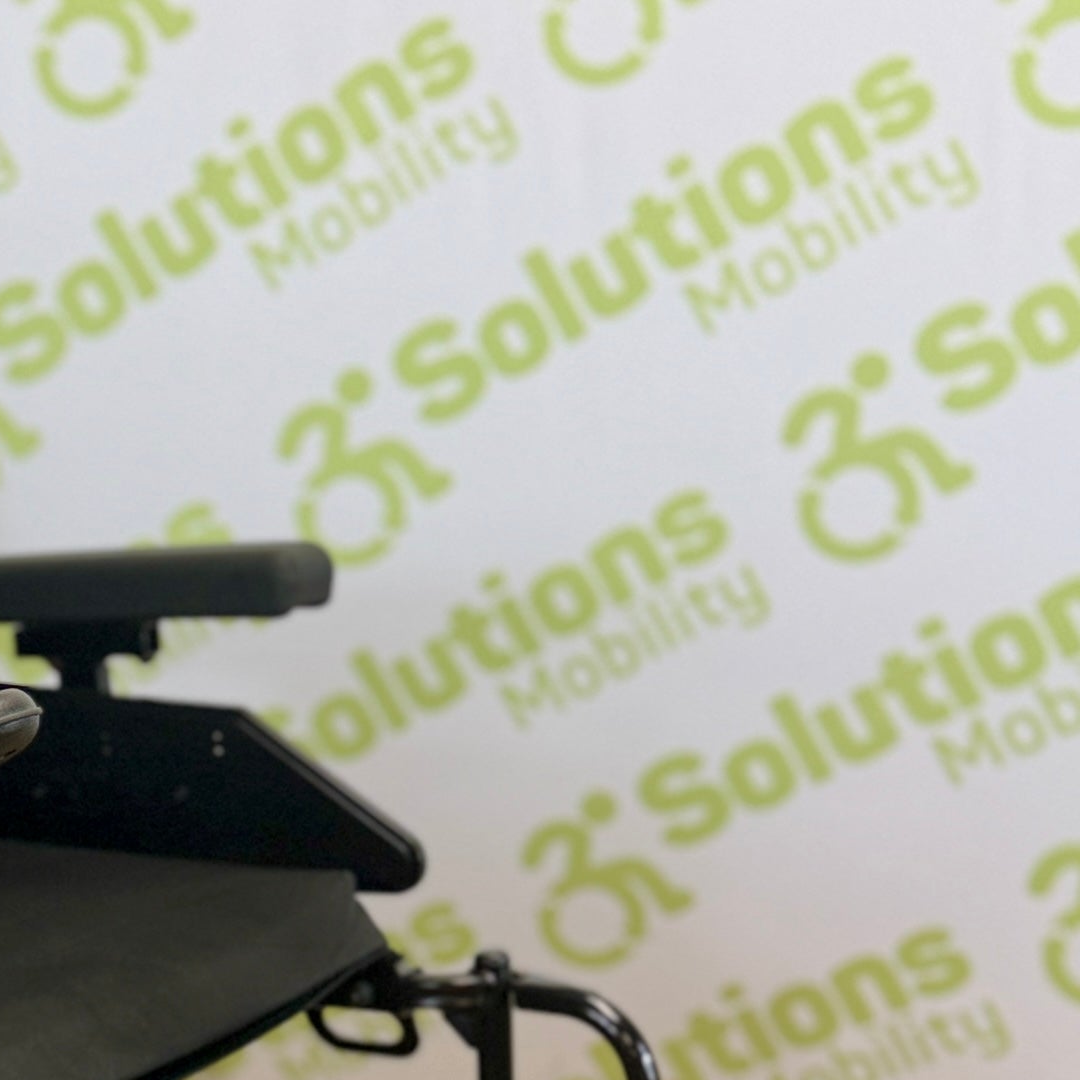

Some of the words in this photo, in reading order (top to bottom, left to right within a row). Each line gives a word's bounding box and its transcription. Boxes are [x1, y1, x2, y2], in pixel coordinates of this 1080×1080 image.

[250, 98, 518, 289] Mobility
[391, 53, 936, 425] Solutions
[684, 138, 982, 335] Mobility
[498, 563, 771, 727] Mobility
